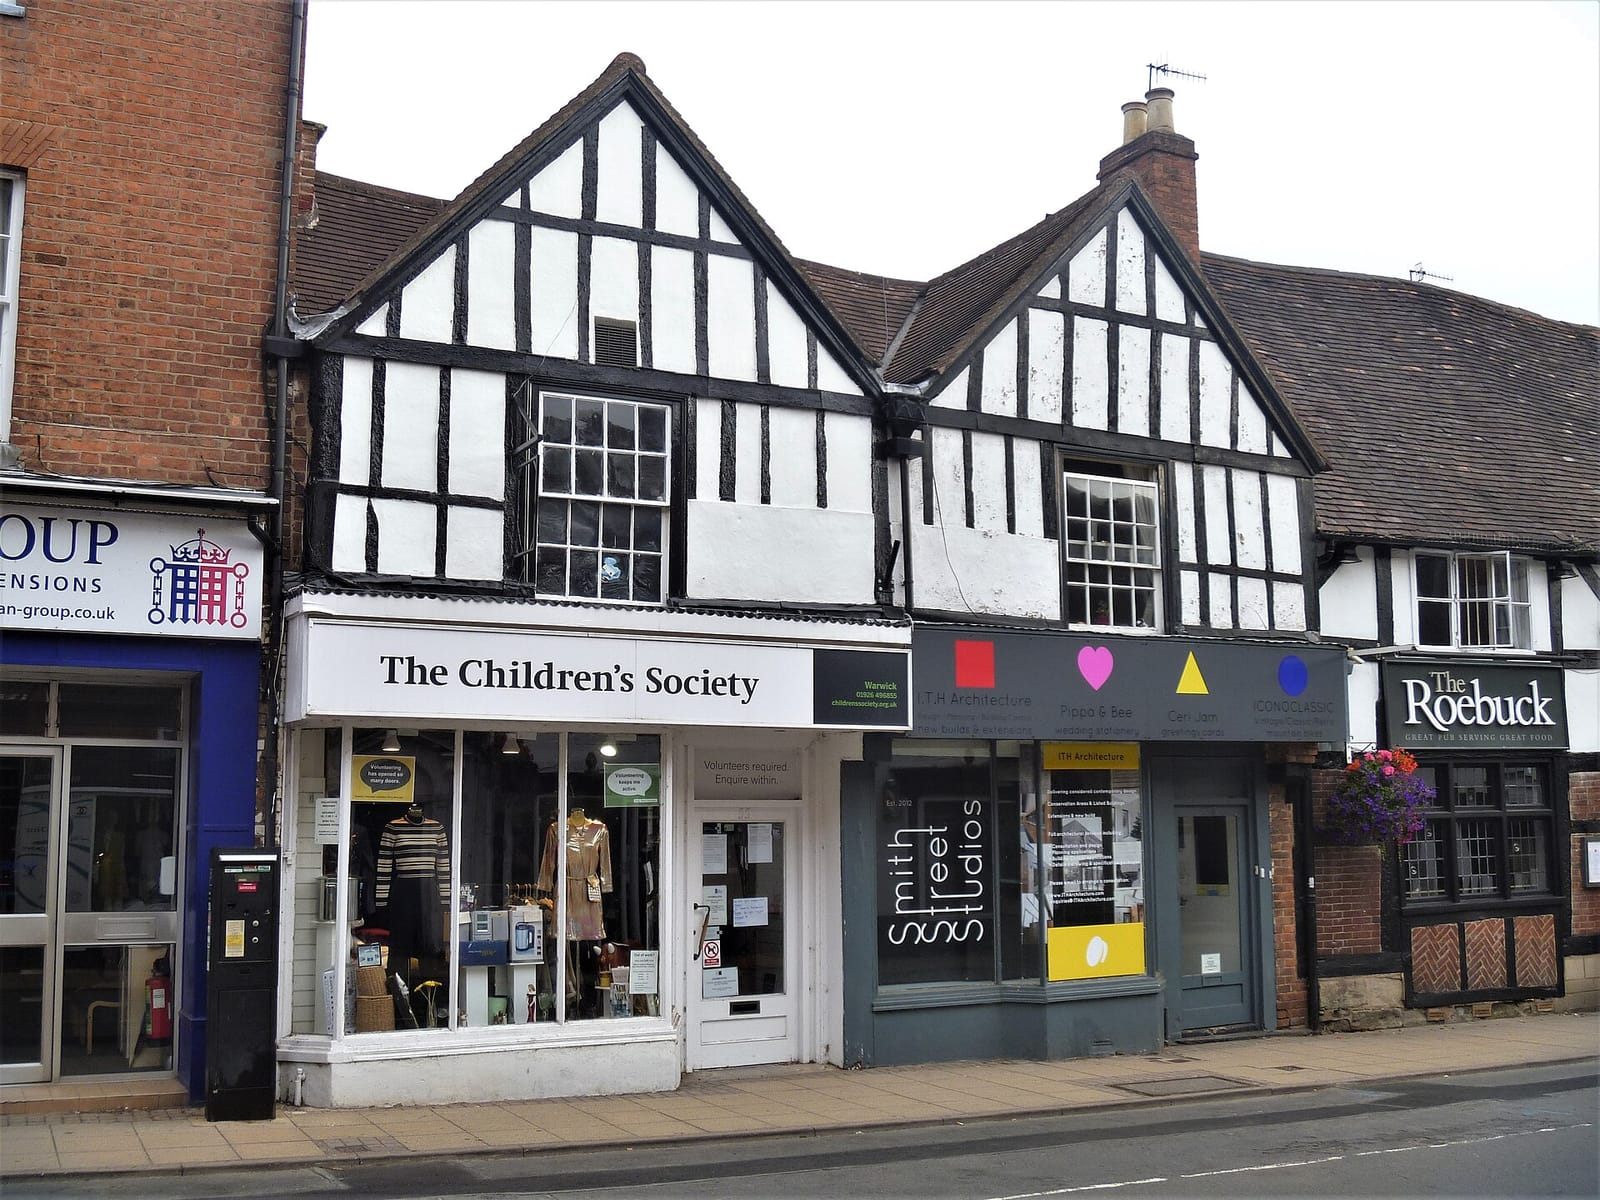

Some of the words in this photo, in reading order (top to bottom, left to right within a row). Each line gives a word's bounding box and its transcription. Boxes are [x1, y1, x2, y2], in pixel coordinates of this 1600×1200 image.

[0, 514, 119, 565] OUP
[380, 655, 448, 687] The
[457, 659, 634, 693] Children’s
[644, 666, 759, 706] Society
[864, 681, 897, 690] Warwick
[1429, 671, 1466, 694] The
[917, 692, 946, 705] I.T.H
[950, 692, 1033, 706] Architecture
[1401, 678, 1557, 732] Roebuck
[1060, 705, 1095, 719] Pippa
[1098, 705, 1106, 718] &
[1111, 706, 1133, 718] Bee
[1167, 710, 1192, 722] Ceri
[1195, 711, 1218, 723] Jam
[917, 726, 938, 734] new
[941, 724, 970, 734] builds
[982, 726, 1033, 736] extensions
[1055, 726, 1094, 736] wedding
[1096, 726, 1140, 737] stationery
[1161, 728, 1199, 738] greetings
[1201, 728, 1225, 738] cards
[1058, 752, 1072, 761] ITH
[1074, 752, 1125, 761] Architecture
[703, 760, 750, 771] Volunteers
[715, 774, 749, 786] Enquire
[750, 775, 779, 785] within.
[953, 800, 985, 942] Studios
